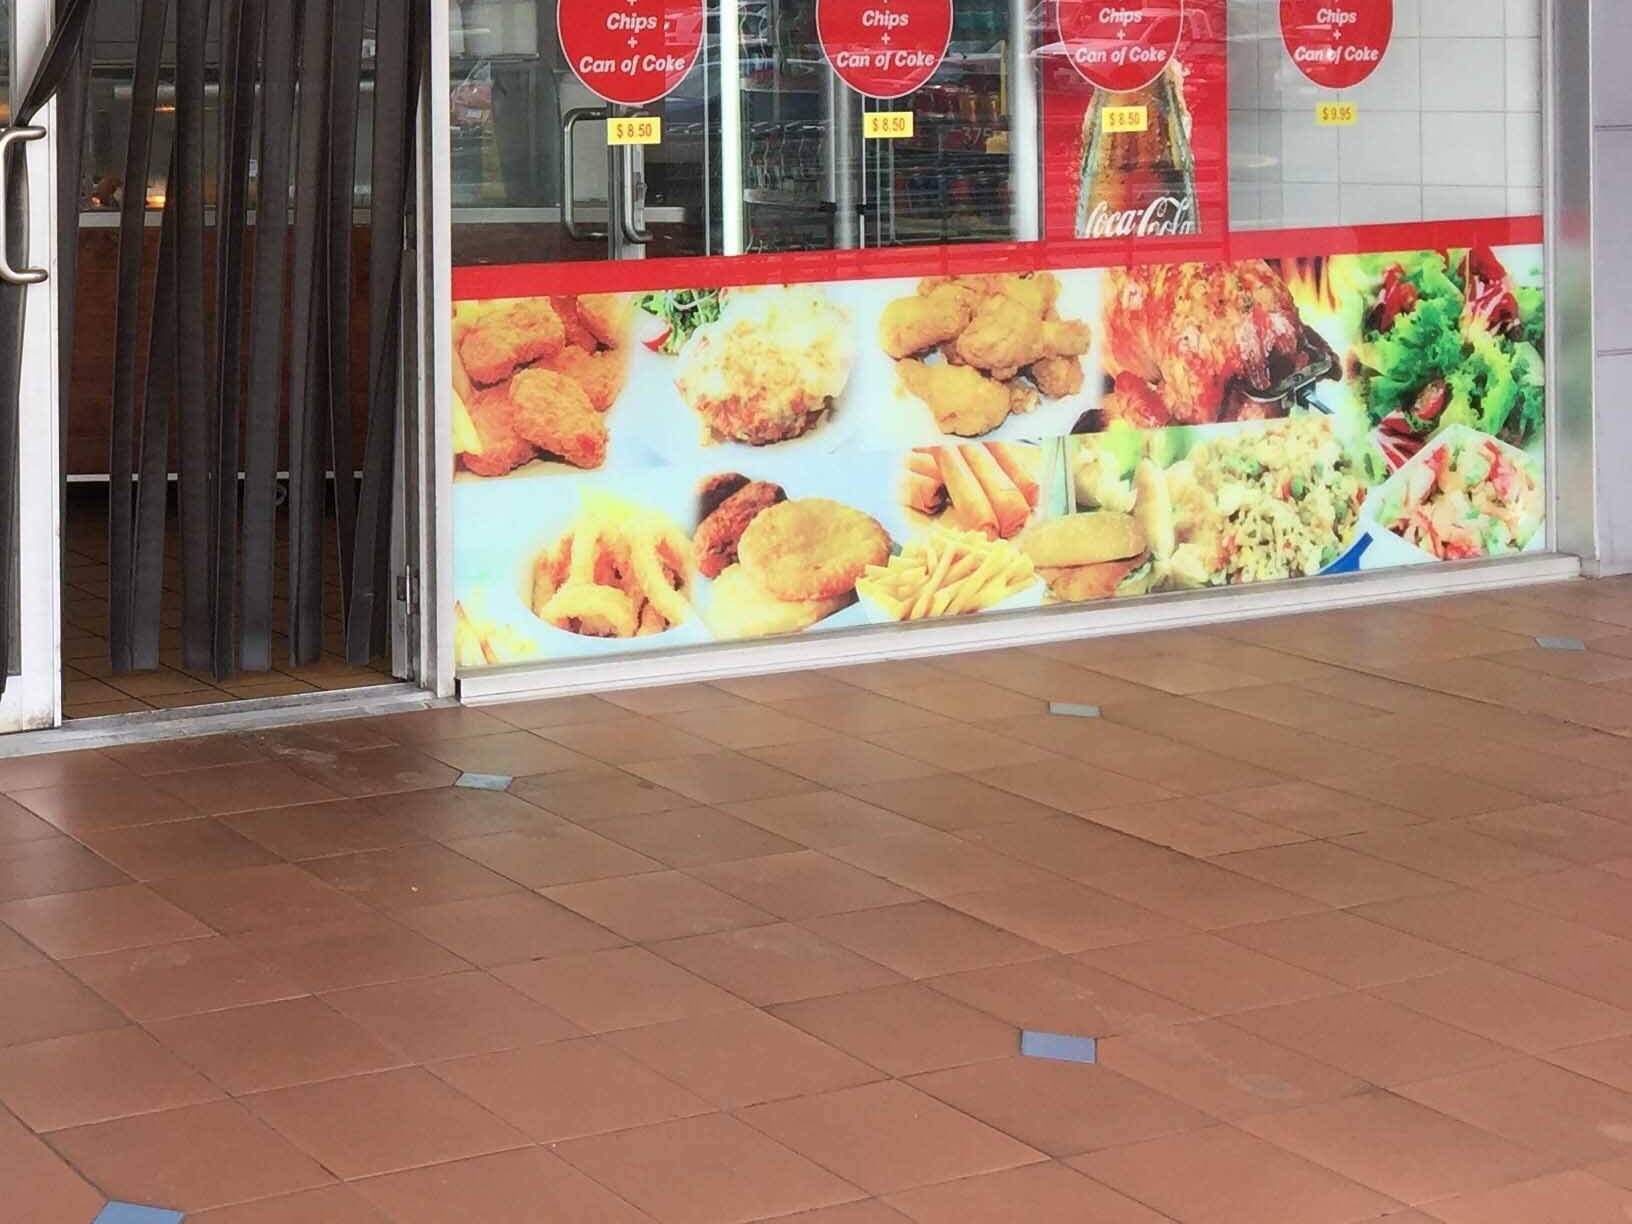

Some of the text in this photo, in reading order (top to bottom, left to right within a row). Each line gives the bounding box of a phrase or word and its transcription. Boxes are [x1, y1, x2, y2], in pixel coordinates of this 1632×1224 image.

[606, 13, 658, 34] Chips
[862, 10, 909, 30] Chips
[1099, 7, 1143, 26] Chips
[1316, 8, 1357, 27] Chips
[627, 36, 638, 48] +
[881, 33, 891, 45] +
[1117, 29, 1126, 41] +
[1333, 29, 1342, 41] +
[836, 51, 935, 70] Can of Coke
[1075, 46, 1167, 65] Can of Coke
[1294, 46, 1378, 64] Can of Coke
[579, 54, 686, 76] Can of Coke
[616, 123, 652, 139] $ 8.50
[872, 117, 905, 132] $ 8.50
[1084, 196, 1195, 238] Coca-Cola
